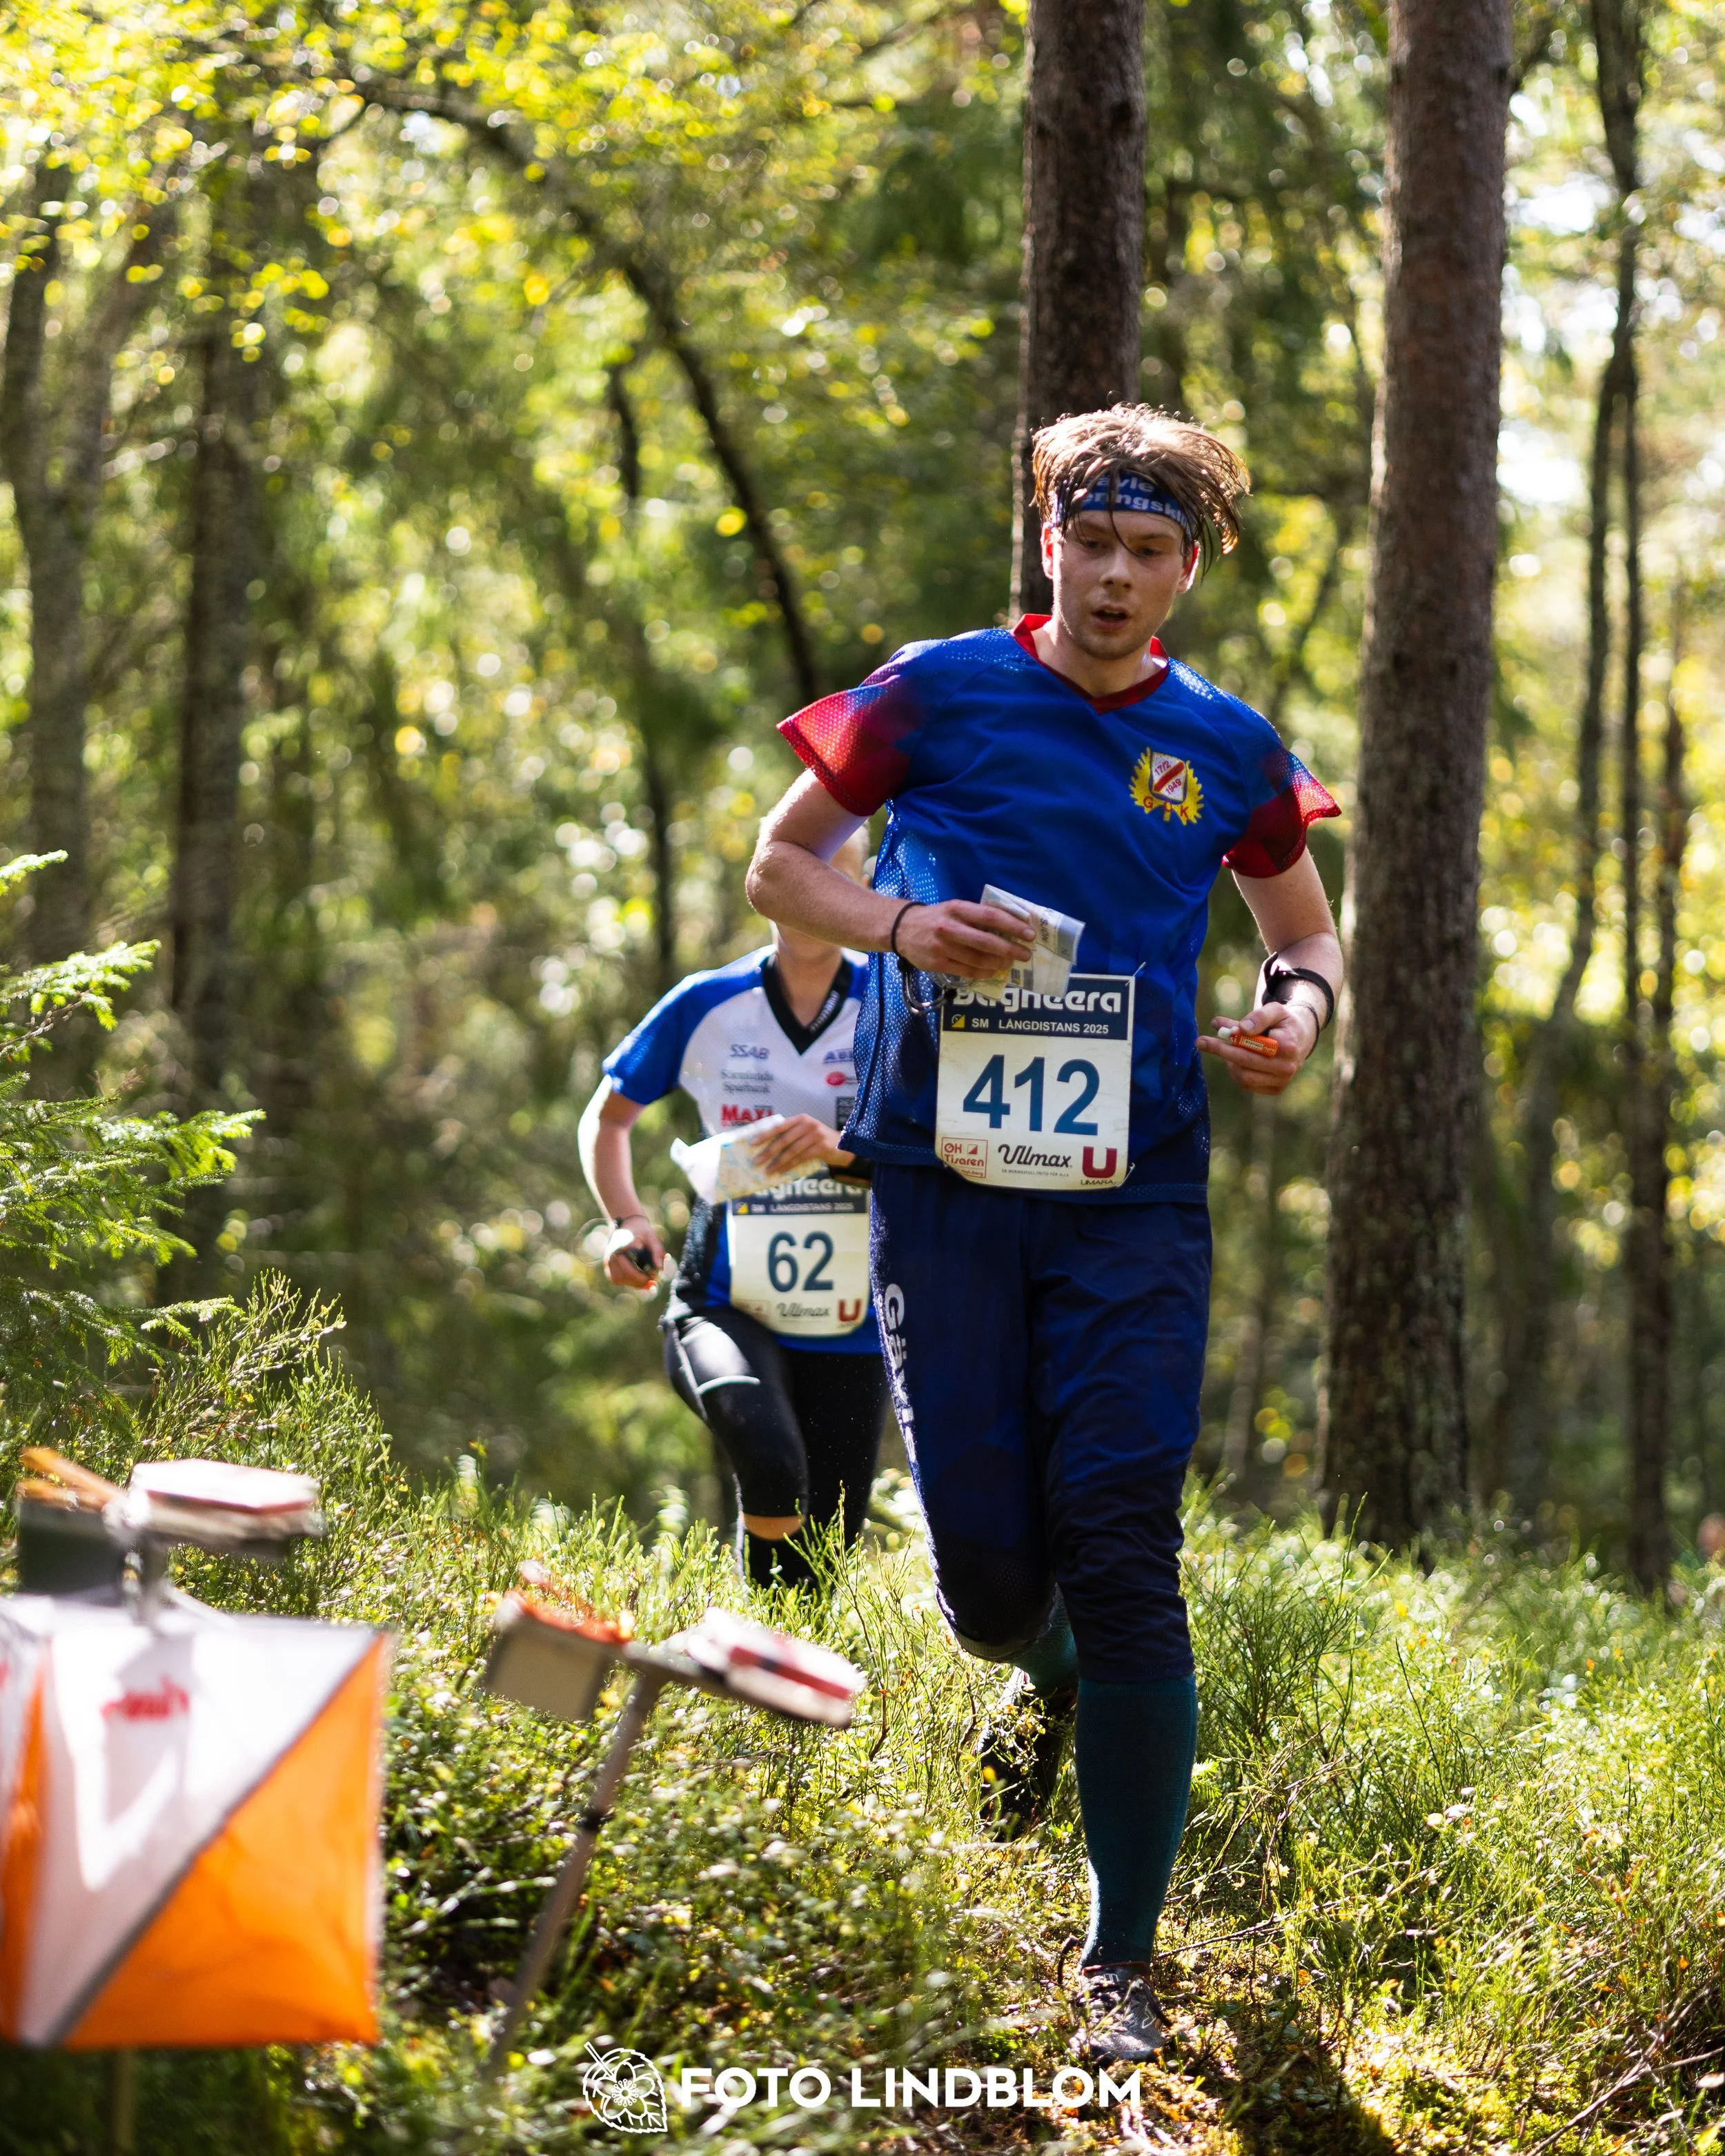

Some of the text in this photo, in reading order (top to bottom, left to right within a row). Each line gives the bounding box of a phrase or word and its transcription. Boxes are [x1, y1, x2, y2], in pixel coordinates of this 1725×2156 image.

[1165, 778, 1182, 795] 1949
[972, 1018, 1109, 1034] SM LÅNGDISTANS 2025
[730, 1044, 769, 1059] SSAB
[963, 1054, 1101, 1136] 412
[944, 1154, 984, 1167] Tisaren
[998, 1143, 1072, 1168] Ullmax
[768, 1230, 834, 1293] 62
